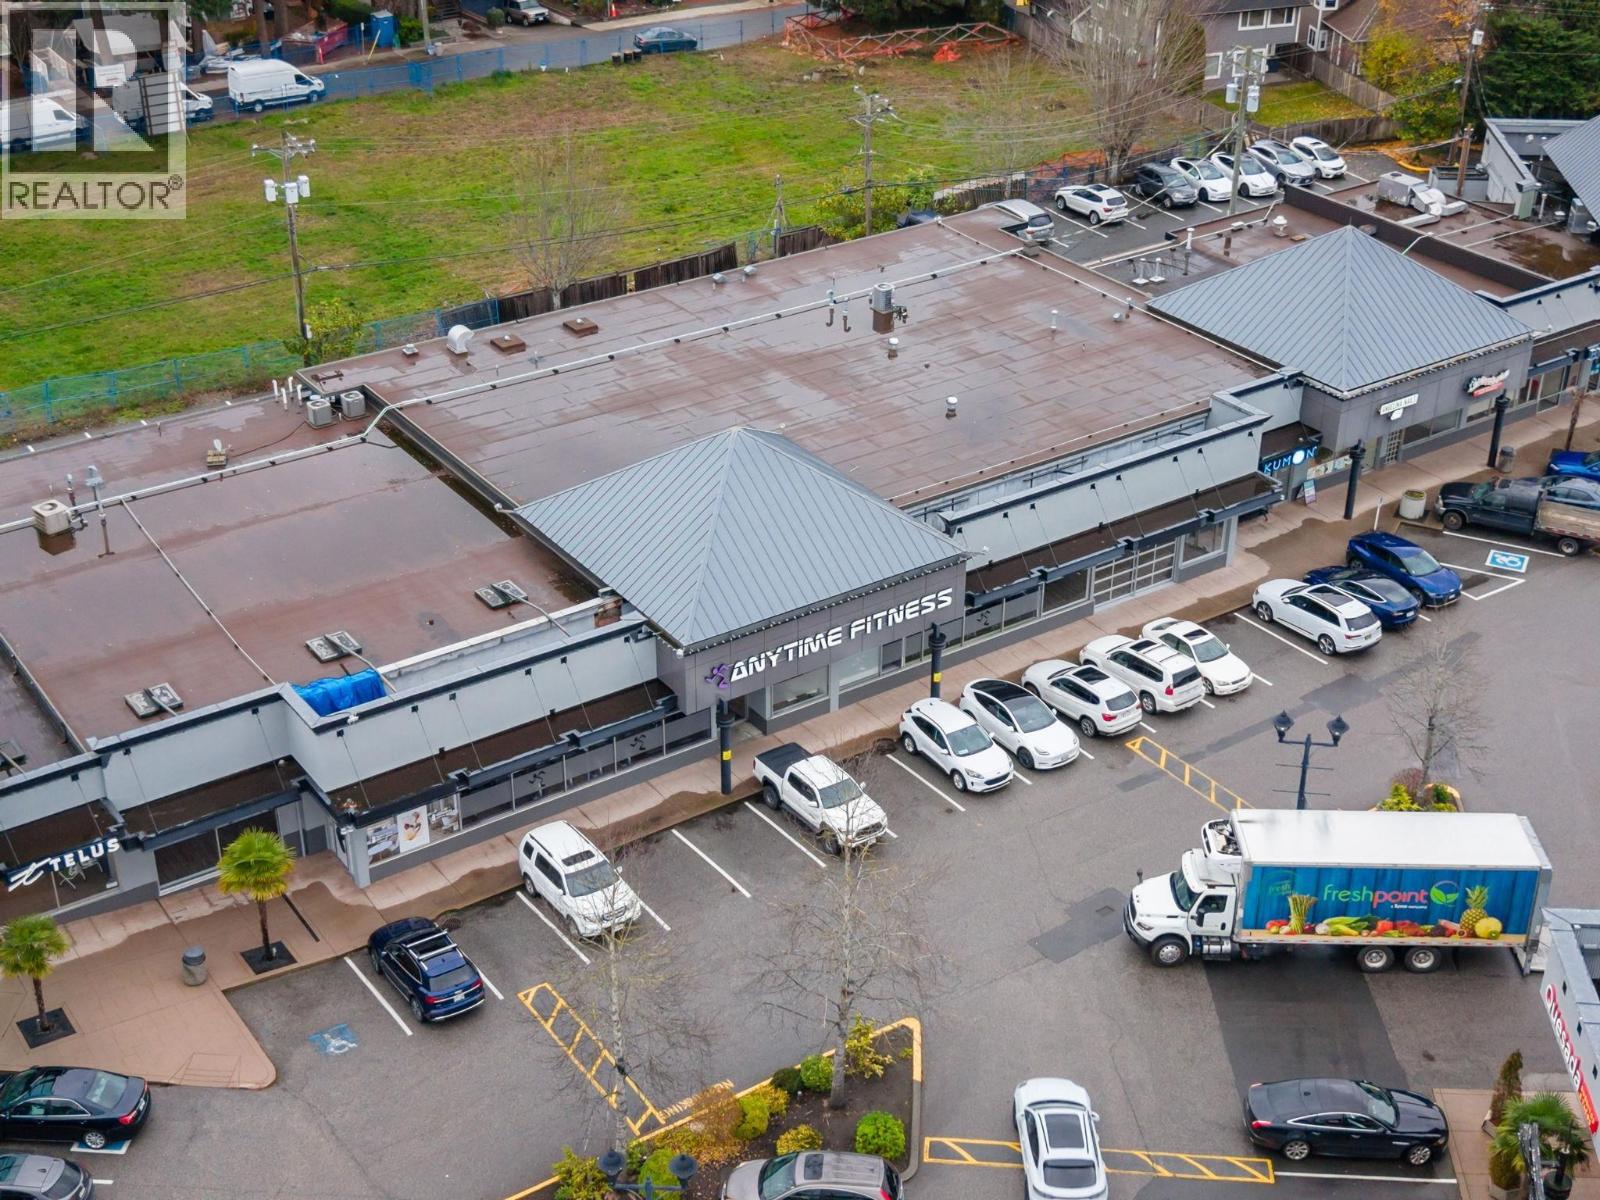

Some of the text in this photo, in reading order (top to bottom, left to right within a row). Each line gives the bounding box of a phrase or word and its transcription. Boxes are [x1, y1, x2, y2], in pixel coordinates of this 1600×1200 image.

[1264, 447, 1316, 474] KUMON
[731, 588, 953, 682] ANYTIME FITNESS
[49, 838, 120, 871] TELUS
[1323, 884, 1429, 909] freshpoint
[1545, 984, 1584, 1092] Quesada
